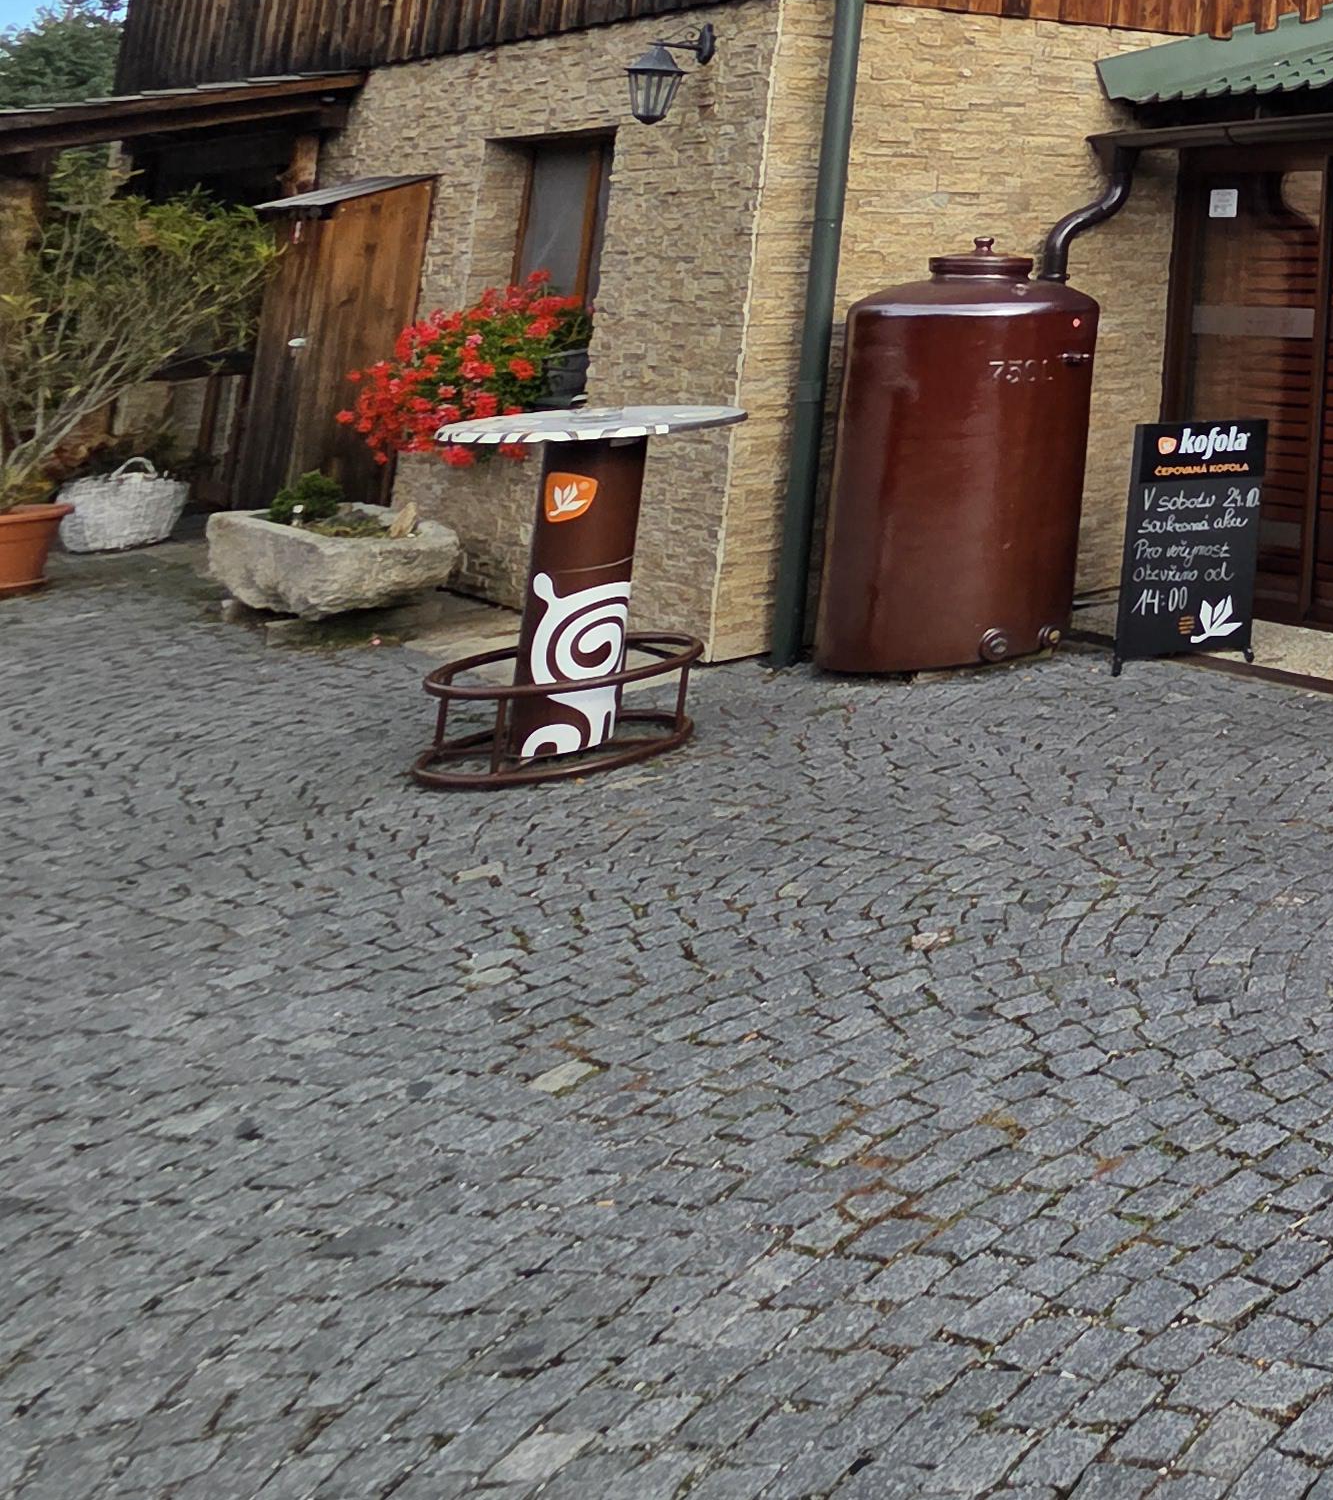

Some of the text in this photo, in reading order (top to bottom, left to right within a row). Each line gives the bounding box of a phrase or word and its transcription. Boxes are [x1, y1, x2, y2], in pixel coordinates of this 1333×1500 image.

[1178, 426, 1249, 460] kofola
[1154, 462, 1249, 477] ČEPOVANÁ KOFOLA
[1144, 487, 1157, 511] V
[1156, 489, 1217, 512] sobotu
[1137, 507, 1249, 534] soukromá akce
[1133, 538, 1163, 560] Pro
[1204, 561, 1235, 582] od
[1131, 586, 1189, 616] 14:00
